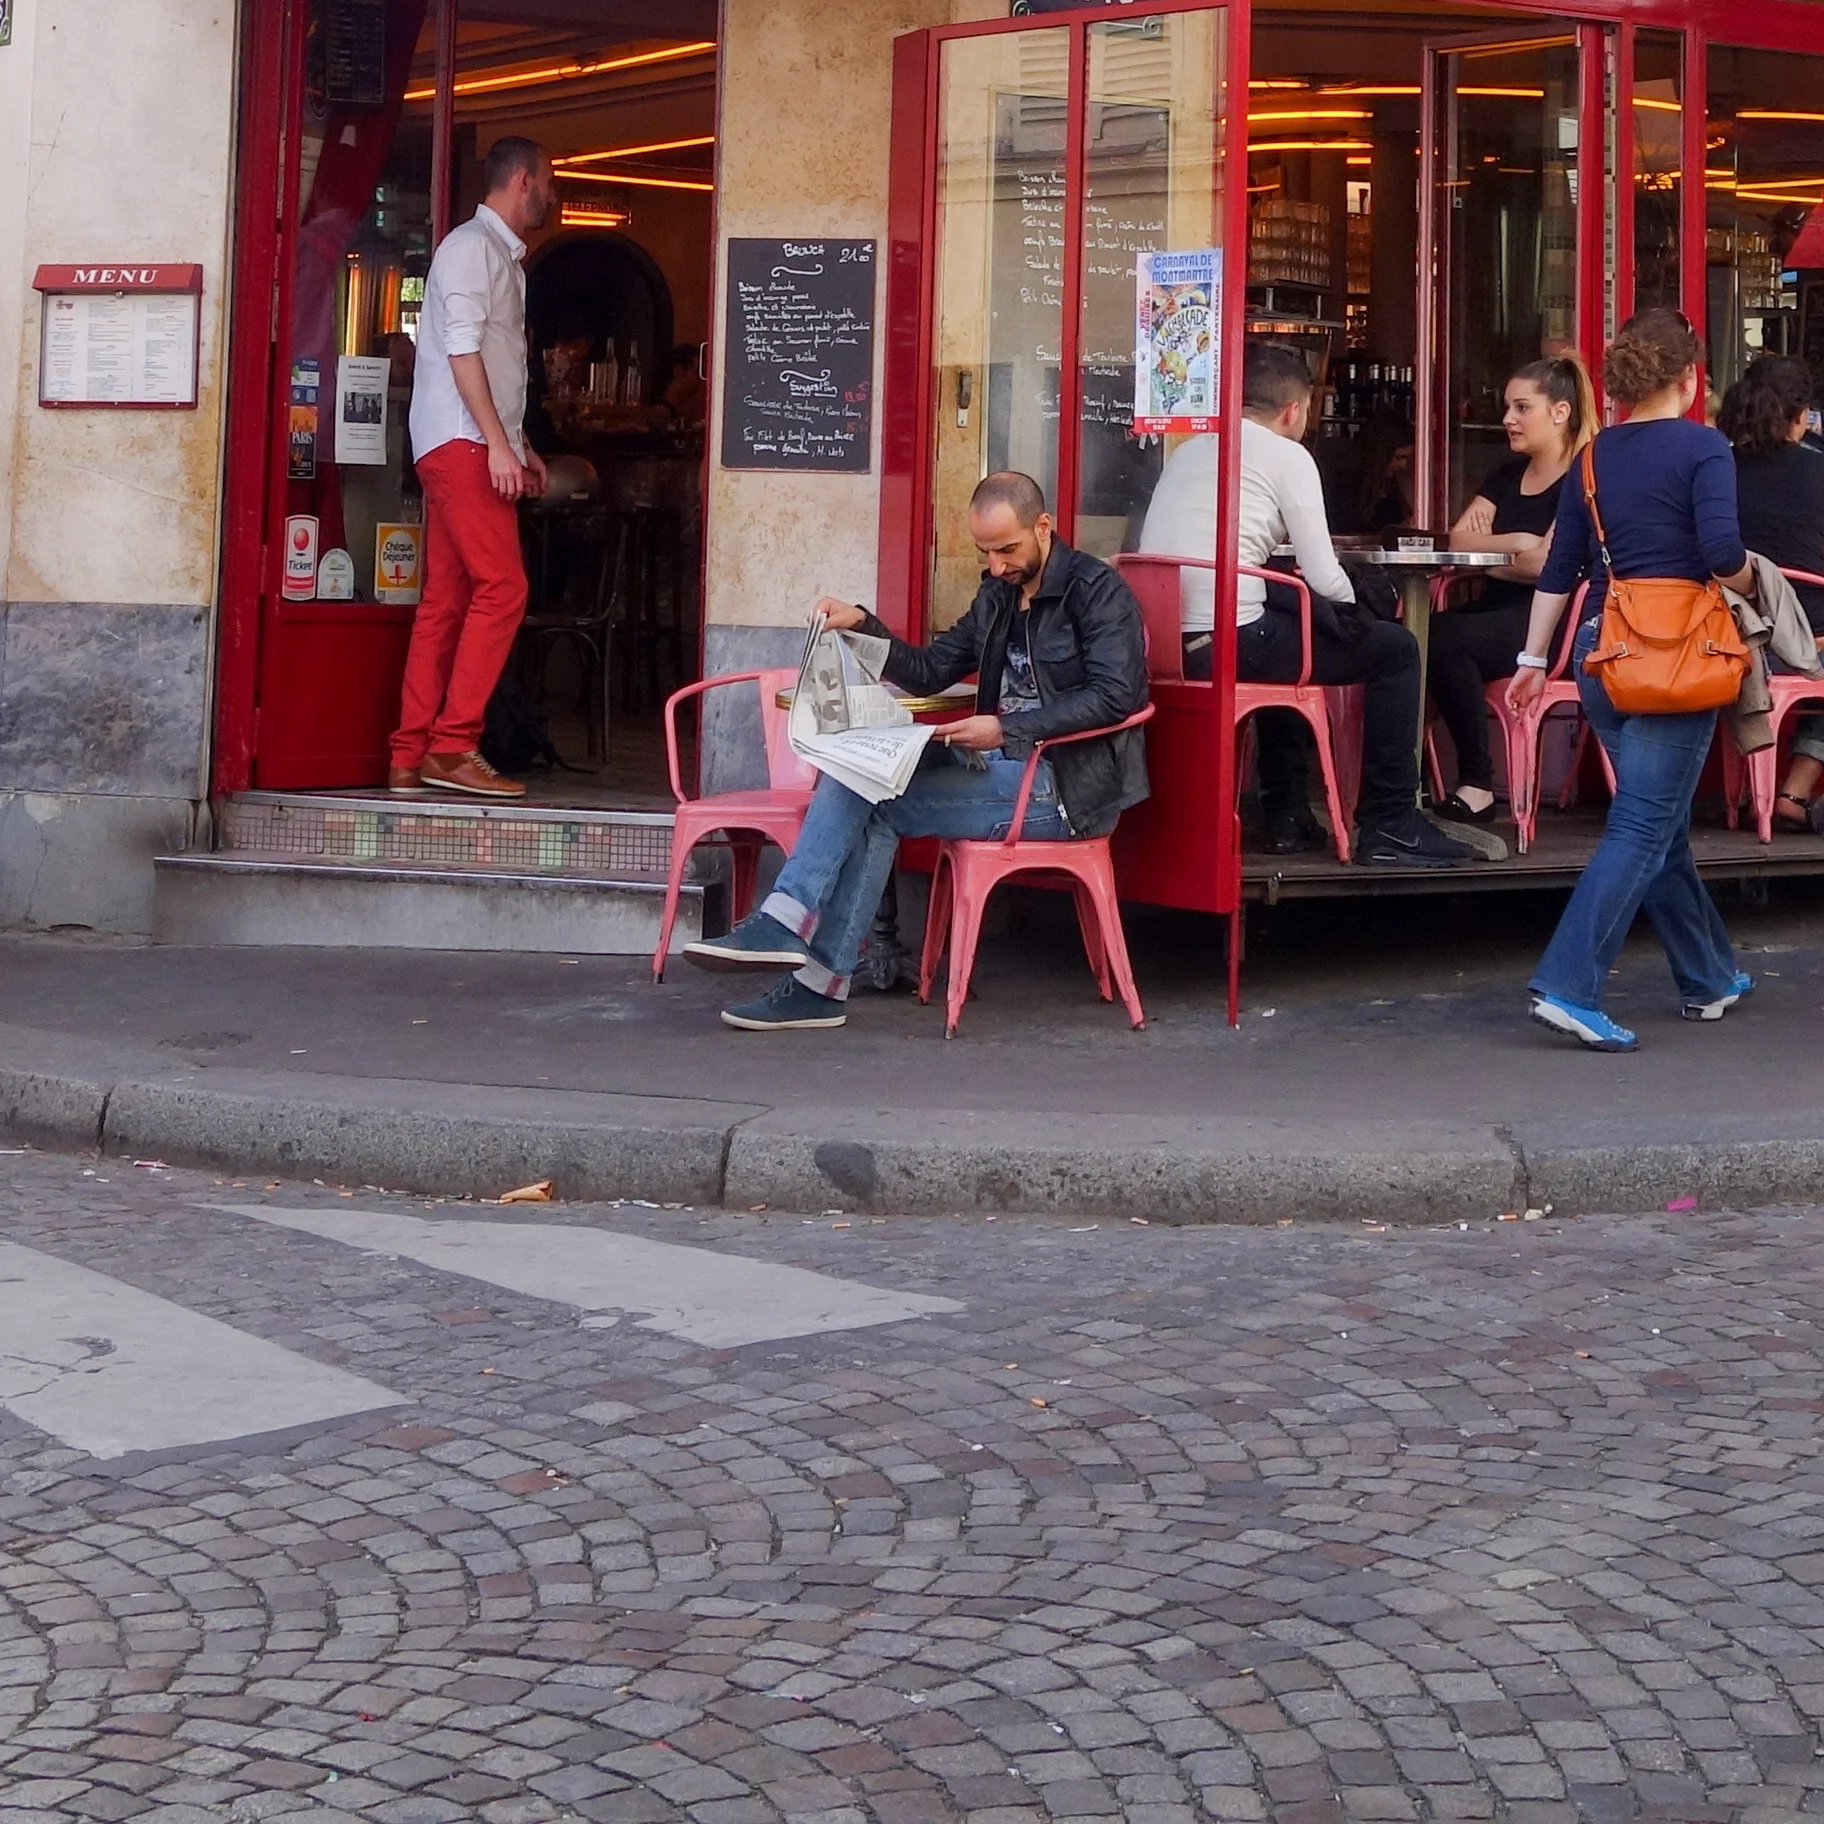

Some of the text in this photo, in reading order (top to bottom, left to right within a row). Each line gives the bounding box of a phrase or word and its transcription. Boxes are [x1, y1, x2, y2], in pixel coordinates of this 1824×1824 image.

[1153, 254, 1212, 269] CARNAVAL DE
[72, 269, 158, 284] MENU
[1152, 268, 1213, 283] MONTMARTRE
[292, 431, 313, 444] PARIS
[385, 542, 413, 552] Chèque
[383, 552, 415, 564] Déjeuner
[289, 560, 312, 571] Ticket
